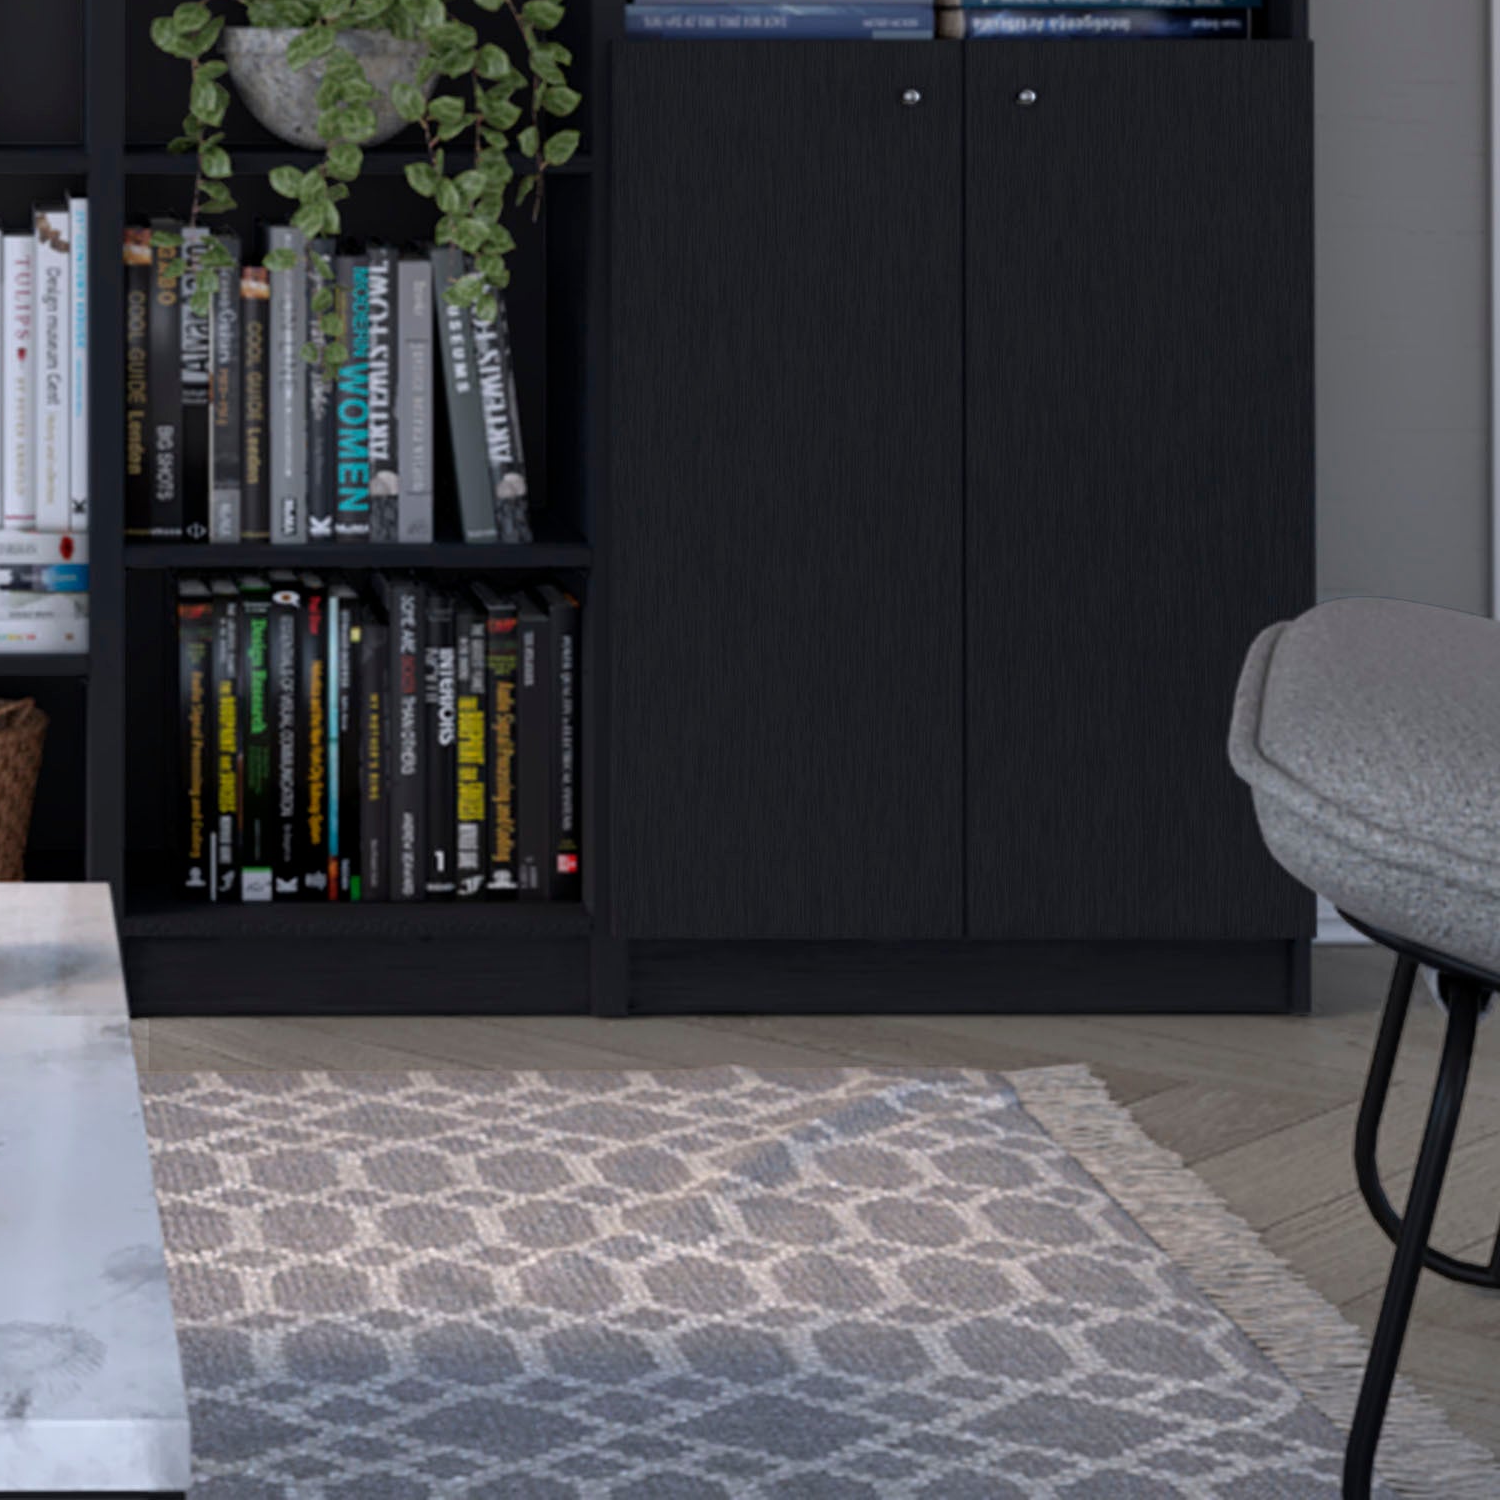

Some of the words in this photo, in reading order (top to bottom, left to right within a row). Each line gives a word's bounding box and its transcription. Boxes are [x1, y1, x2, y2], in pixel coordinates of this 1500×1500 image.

[15, 255, 32, 340] TULIPS
[43, 267, 61, 312] Design
[128, 290, 145, 341] COOL
[352, 266, 369, 358] MODERN
[368, 260, 389, 334] FOWL
[247, 321, 262, 368] COOL
[446, 303, 470, 394] USEUMS
[128, 347, 145, 405] GUIDE
[247, 371, 262, 421] GUIDE
[368, 345, 389, 461] ARTEMIS
[128, 410, 145, 476] London
[156, 425, 175, 450] BIG
[247, 426, 262, 485] London
[338, 363, 369, 512] WOMEN
[156, 453, 175, 502] SHOTS
[248, 619, 267, 666] Design
[248, 671, 267, 734] Research
[438, 647, 455, 746] INTERIORS
